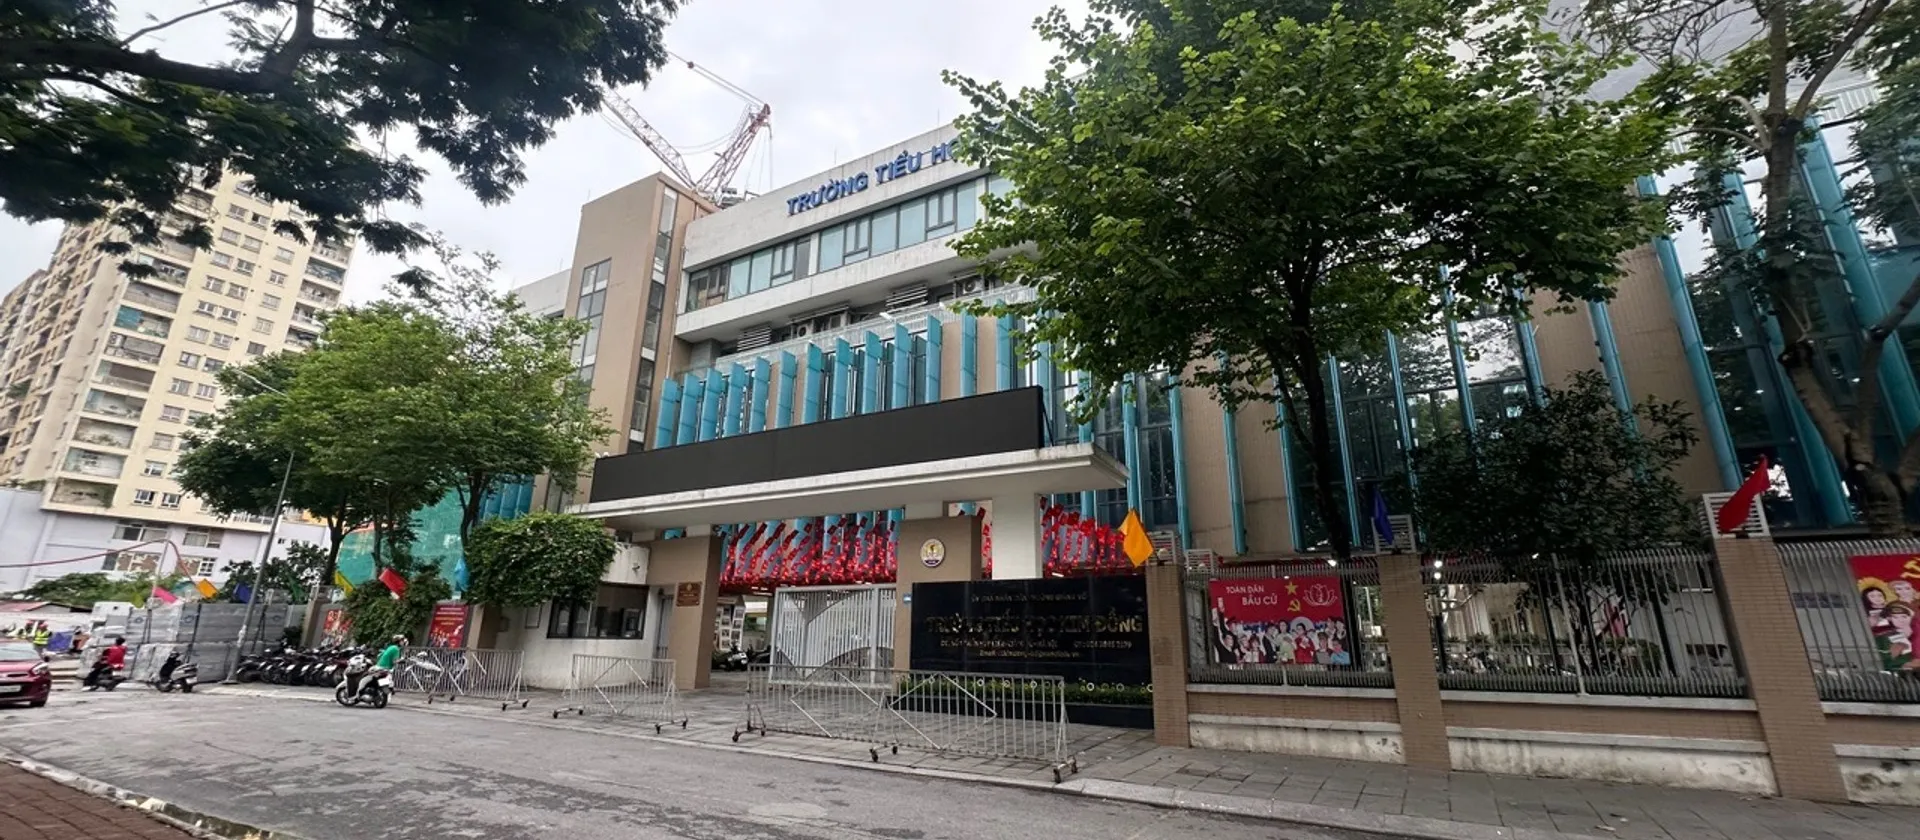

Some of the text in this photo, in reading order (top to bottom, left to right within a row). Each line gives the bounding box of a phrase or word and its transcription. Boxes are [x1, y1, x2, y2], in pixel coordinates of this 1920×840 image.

[787, 173, 869, 216] TRƯỜNG
[874, 149, 922, 185] TIỂU
[1093, 606, 1143, 633] ĐỒNG
